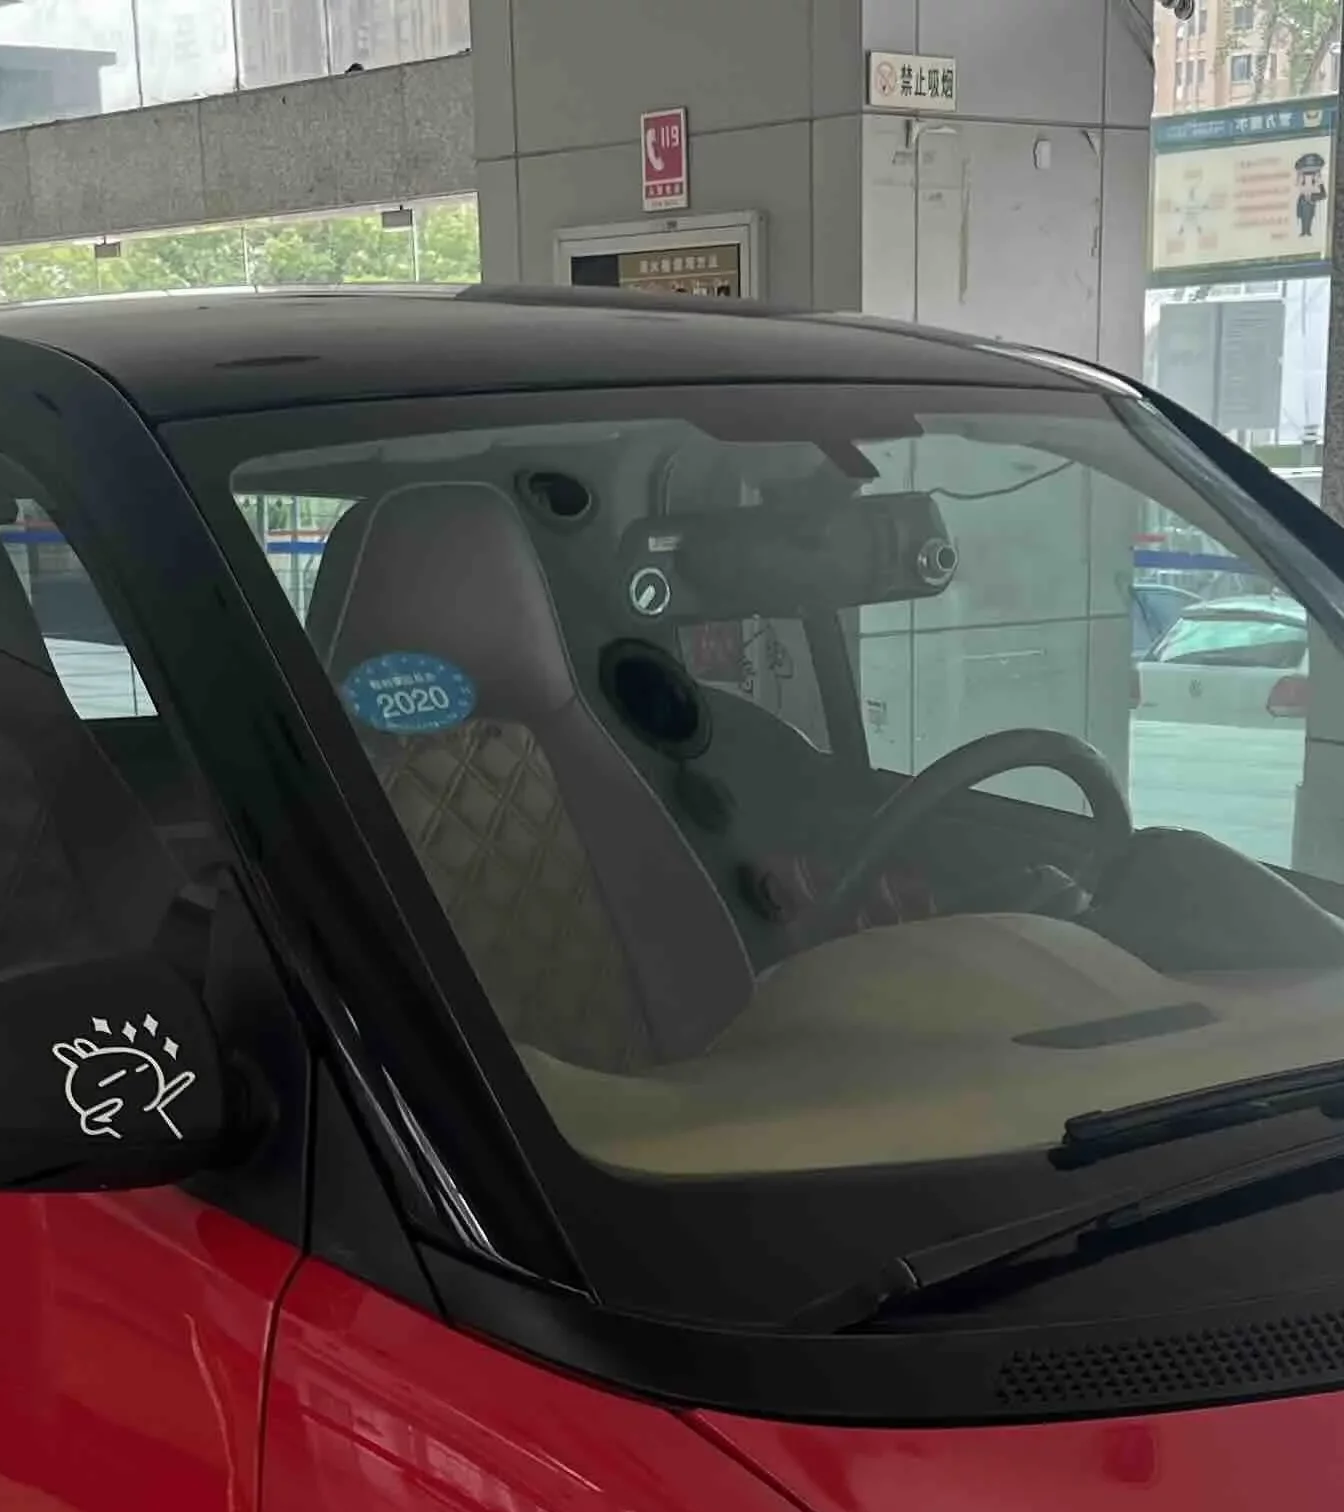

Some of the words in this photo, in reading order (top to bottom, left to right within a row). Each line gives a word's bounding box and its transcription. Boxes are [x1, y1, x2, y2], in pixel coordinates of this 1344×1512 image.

[900, 63, 953, 98] 禁止吸烟
[661, 125, 680, 149] 119
[376, 685, 450, 719] 2020
